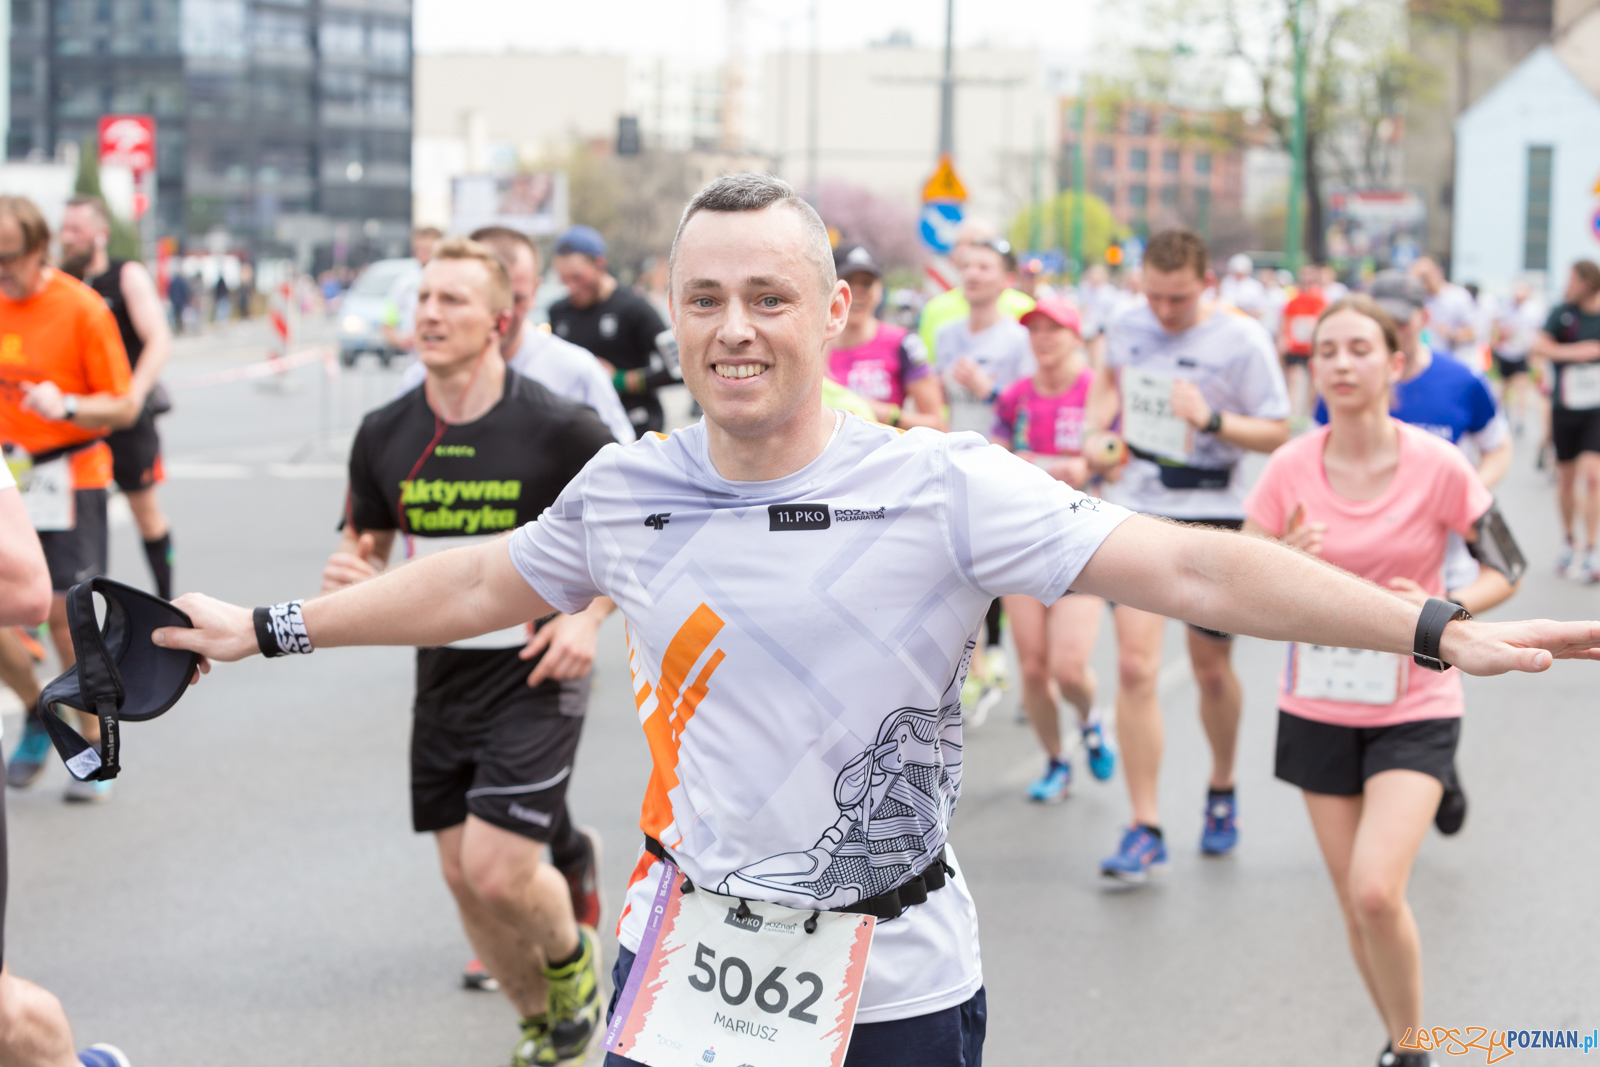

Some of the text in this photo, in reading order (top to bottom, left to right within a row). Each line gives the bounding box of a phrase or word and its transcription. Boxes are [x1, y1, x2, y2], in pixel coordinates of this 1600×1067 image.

[400, 479, 521, 506] Aktywna
[644, 513, 672, 530] 4F
[104, 715, 115, 767] Kalenji
[654, 905, 664, 915] D
[687, 941, 824, 1025] 5062
[713, 1011, 779, 1042] MARIUSZ
